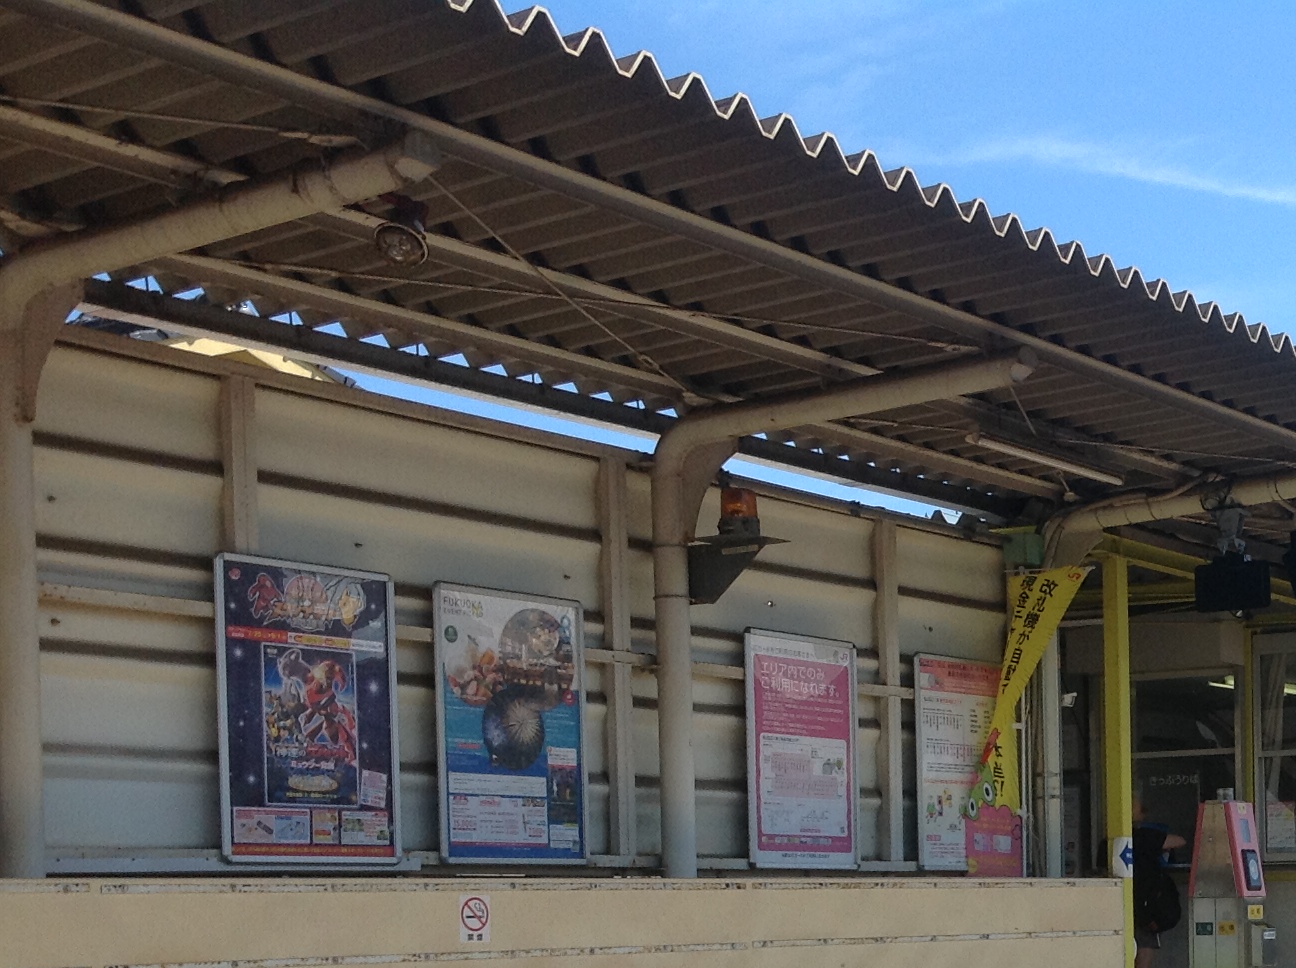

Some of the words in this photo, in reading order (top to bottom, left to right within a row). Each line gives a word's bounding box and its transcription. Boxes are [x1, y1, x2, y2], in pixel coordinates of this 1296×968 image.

[761, 662, 826, 681] エリア内でのみ
[761, 676, 840, 698] ご利用になれます。
